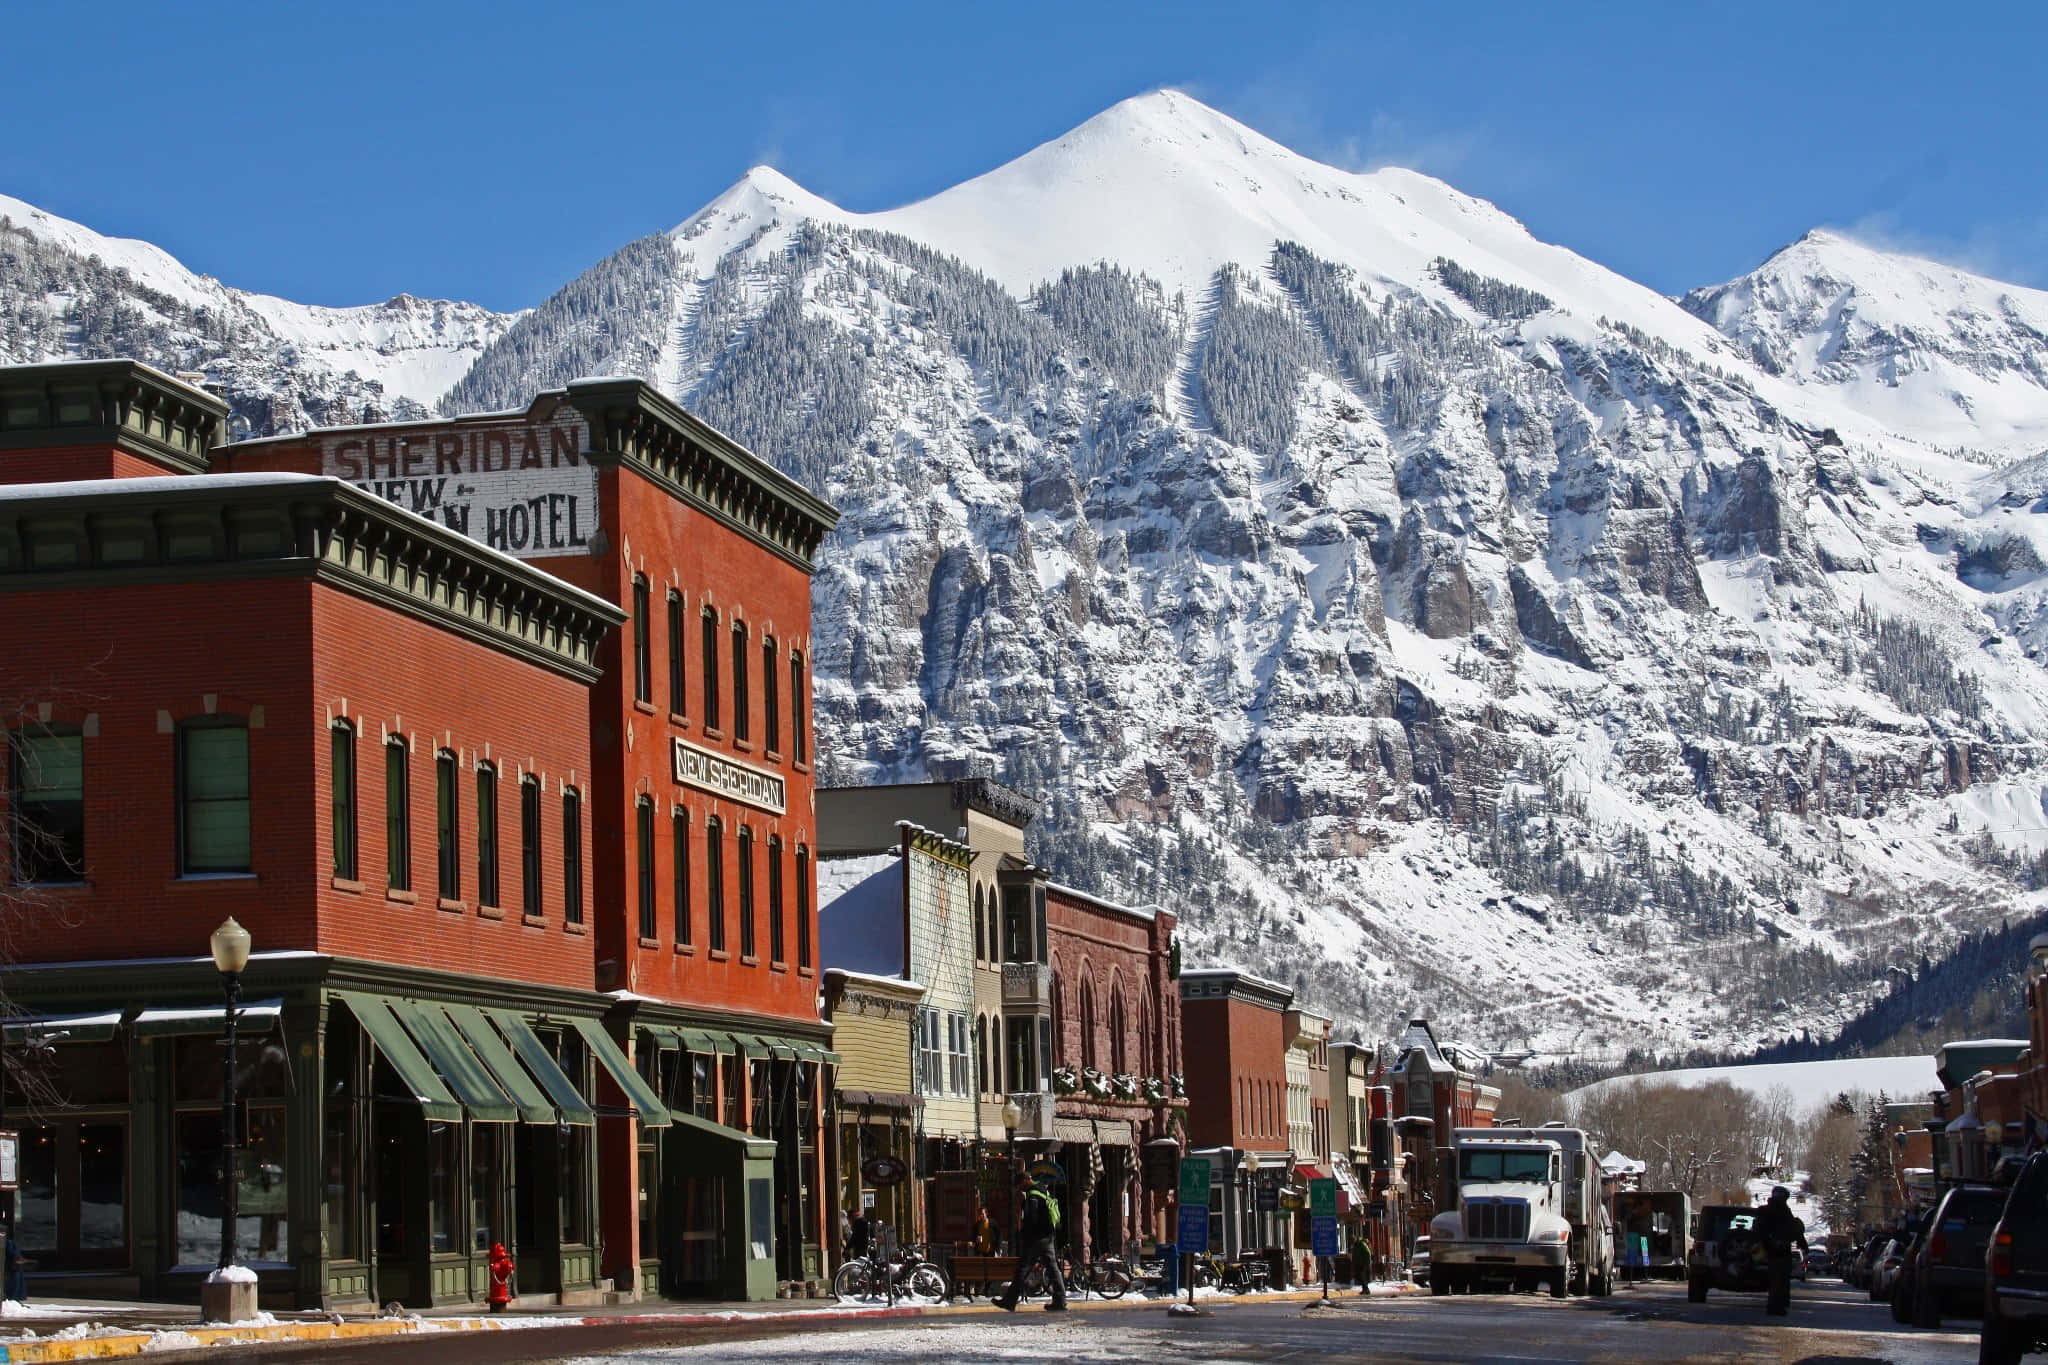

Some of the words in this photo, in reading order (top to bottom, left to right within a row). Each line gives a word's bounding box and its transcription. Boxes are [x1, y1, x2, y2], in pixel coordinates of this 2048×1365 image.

[334, 425, 579, 480] SHERIDAN
[486, 493, 587, 551] HOTEL
[677, 747, 707, 782] NEW
[710, 760, 779, 806] SHERIDAN
